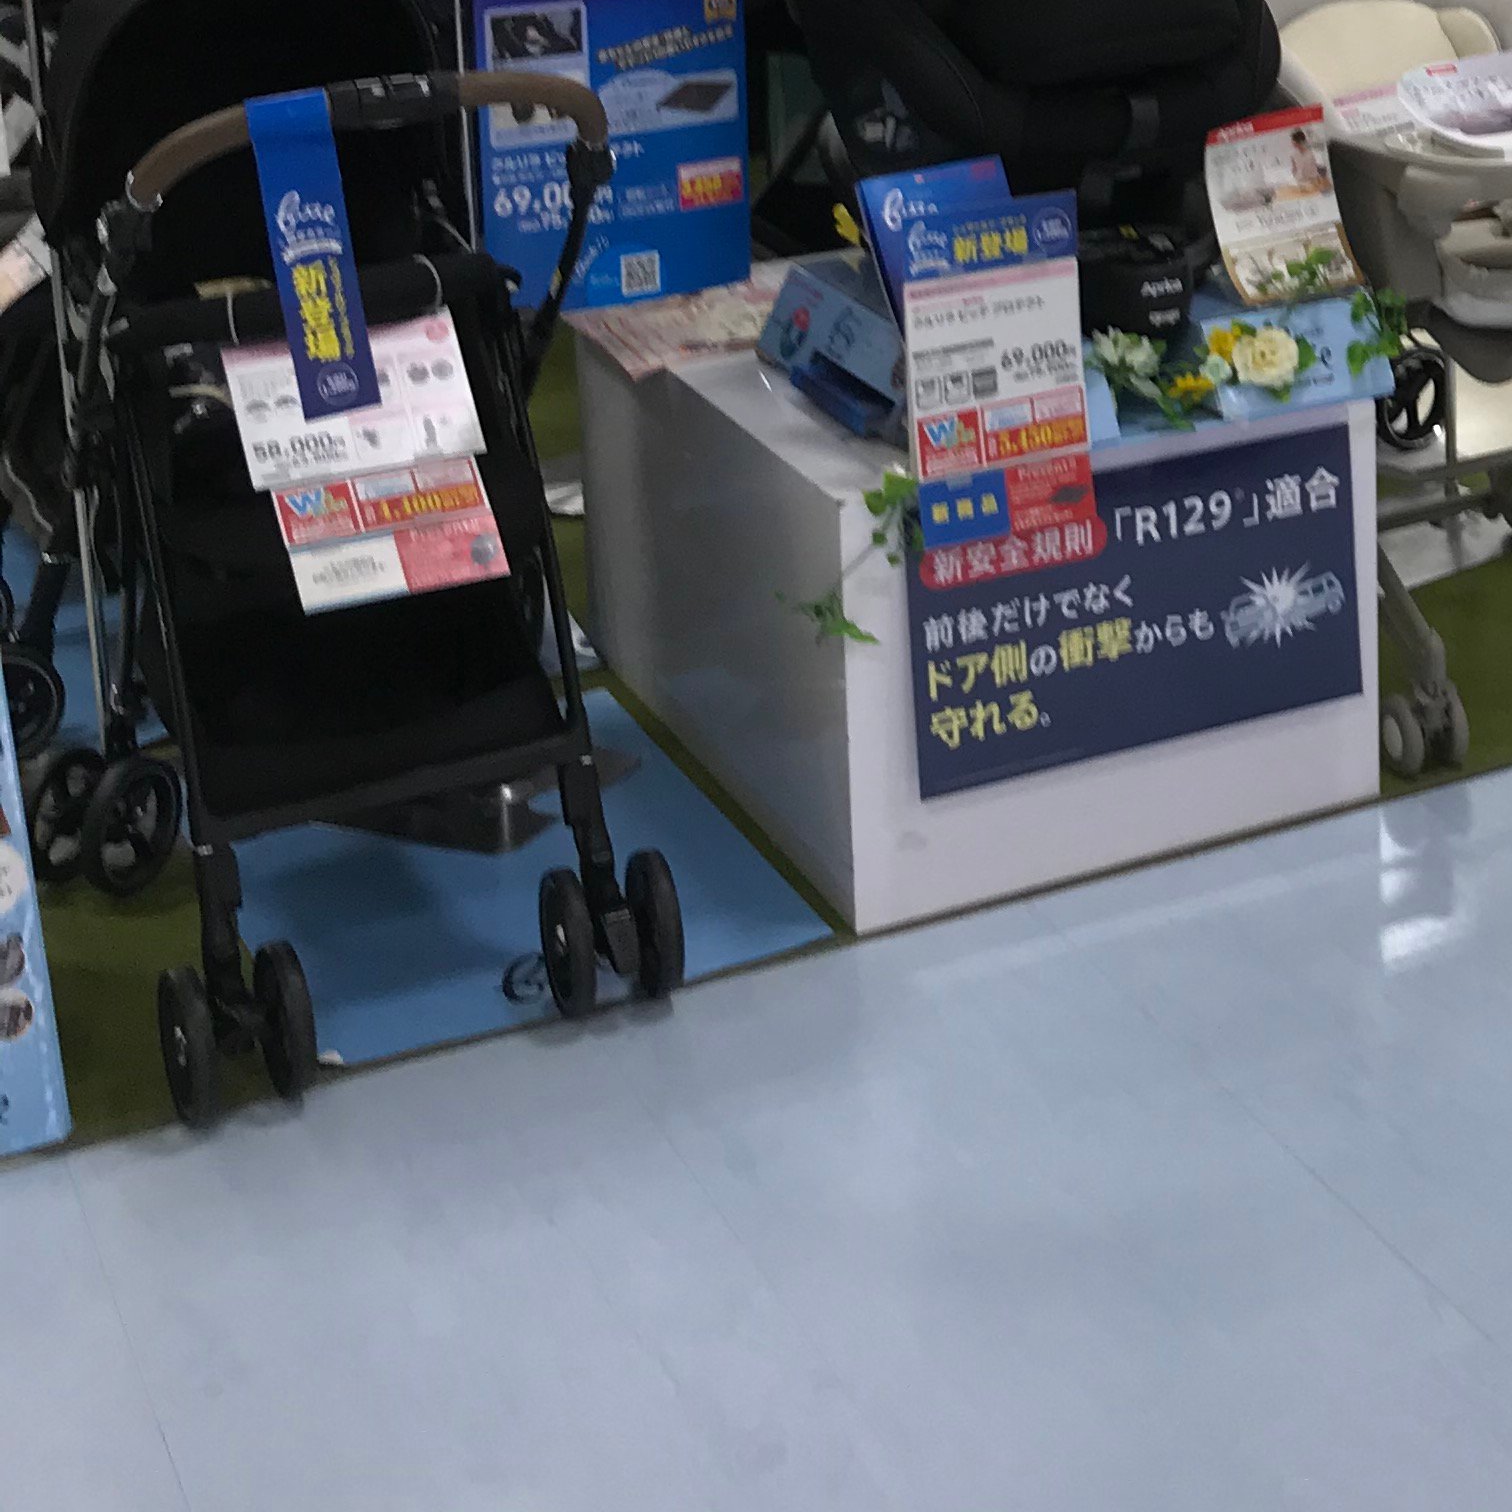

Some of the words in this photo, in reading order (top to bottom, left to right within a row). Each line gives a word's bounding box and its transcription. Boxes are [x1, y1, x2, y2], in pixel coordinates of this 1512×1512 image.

[932, 520, 1094, 586] 新安全規則
[923, 574, 1134, 653] 前後だけでなく
[926, 607, 1215, 702] ドア側の衝撃からも
[929, 690, 1051, 750] 守れる。
